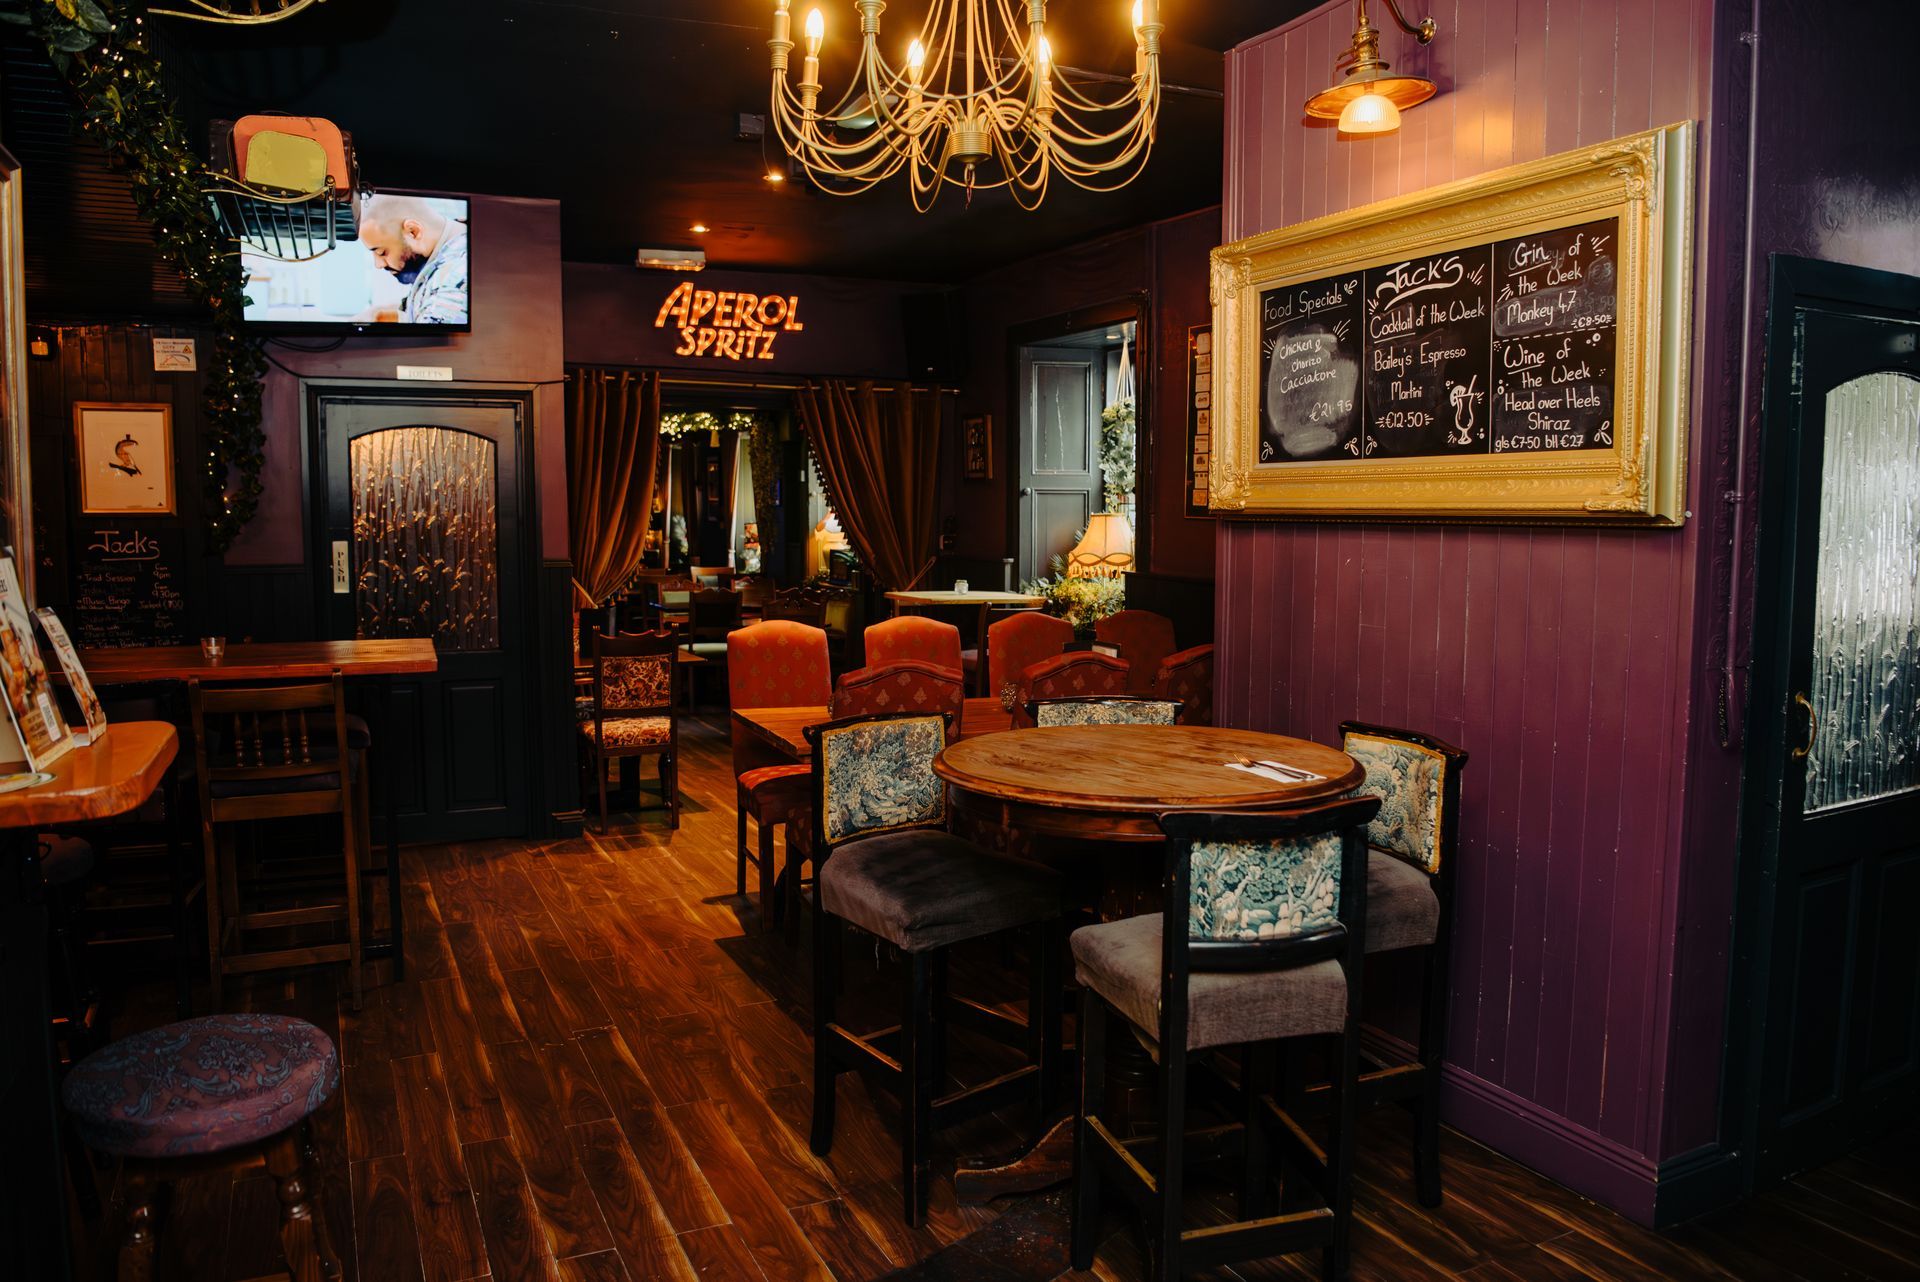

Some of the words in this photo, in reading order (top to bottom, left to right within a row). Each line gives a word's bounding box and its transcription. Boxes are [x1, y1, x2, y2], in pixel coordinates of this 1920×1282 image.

[1515, 242, 1549, 267] Gin
[1568, 233, 1584, 256] of
[1518, 276, 1538, 296] the
[1546, 260, 1583, 286] Week
[655, 282, 803, 331] APEROL
[1264, 294, 1293, 322] Food
[1299, 282, 1342, 319] Specials
[1370, 307, 1413, 339] Cocktail
[1415, 305, 1427, 327] of
[1431, 304, 1447, 325] the
[1449, 296, 1485, 322] Week
[1507, 299, 1554, 326] Monkey
[1558, 290, 1577, 314] 47
[1374, 345, 1412, 378] Bailey's
[1420, 341, 1467, 368] Espresso
[1503, 344, 1545, 368] Wine
[1556, 338, 1572, 360] of
[1280, 369, 1337, 394] Cacciatore
[1522, 372, 1543, 389] the
[1551, 361, 1591, 385] Week
[1391, 381, 1423, 401] Martini
[1504, 391, 1535, 412] Head
[1537, 399, 1563, 409] over
[1565, 385, 1601, 409] Heels
[1527, 411, 1571, 431] Shiraz
[1495, 435, 1510, 453] gls
[1560, 434, 1584, 448] €27
[88, 530, 161, 560] Jacks
[337, 551, 345, 583] PUSH
